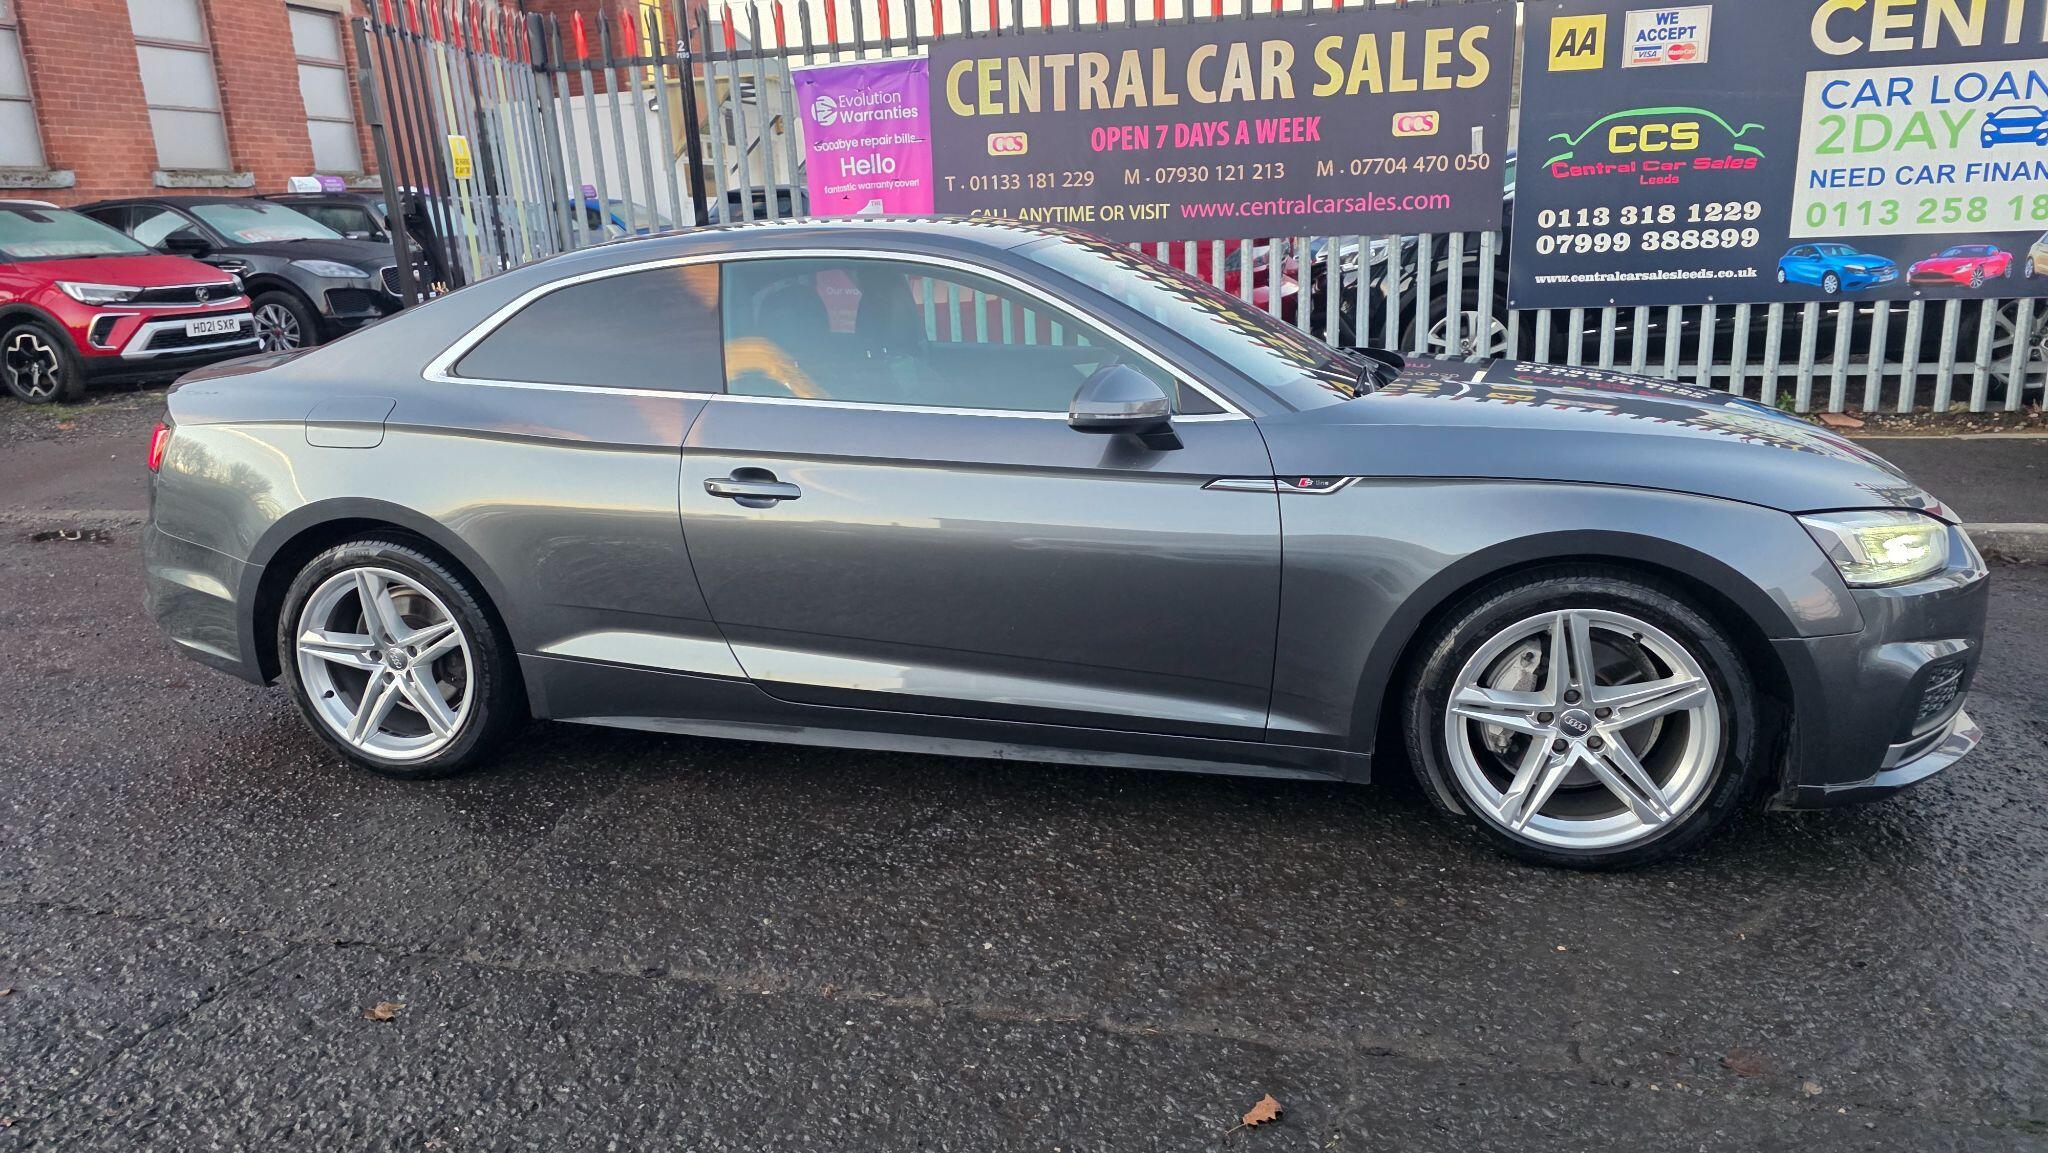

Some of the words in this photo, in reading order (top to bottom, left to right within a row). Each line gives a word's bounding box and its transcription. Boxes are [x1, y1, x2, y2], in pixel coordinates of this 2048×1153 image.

[1656, 12, 1679, 25] WE
[1555, 27, 1597, 57] AA
[1636, 26, 1697, 42] ACCEPT
[677, 40, 685, 51] 2
[1638, 50, 1657, 58] VISA
[946, 48, 1179, 117] CENTRAL
[1187, 39, 1295, 104] CAR
[1312, 25, 1490, 97] SALES
[838, 91, 902, 108] Evolution
[1821, 77, 1914, 110] CAR
[840, 105, 918, 124] Warranties
[814, 139, 858, 152] Goodbye
[860, 134, 893, 148] repair
[1091, 125, 1149, 152] OPEN
[1156, 125, 1169, 149] 7
[1174, 121, 1230, 148] DAYS
[1235, 120, 1250, 145] A
[1255, 116, 1321, 144] WEEK
[1608, 121, 1700, 154] CCS
[1815, 109, 1977, 155] 2DAY
[840, 153, 896, 178] Hello
[1155, 166, 1208, 184] 07930
[1215, 164, 1244, 181] 121
[1252, 162, 1285, 180] 213
[1350, 157, 1407, 176] 07704
[1413, 155, 1448, 173] 470
[1455, 153, 1490, 170] 050
[1551, 161, 1636, 179] Central
[1642, 160, 1687, 172] Car
[1692, 155, 1758, 170] Sales
[824, 183, 857, 194] fantastic
[858, 181, 894, 190] warranty
[894, 179, 920, 187] cover!
[969, 173, 1021, 191] 01133
[1027, 173, 1055, 189] 181
[1063, 170, 1095, 187] 229
[1640, 174, 1679, 185] Leeds
[1809, 167, 1886, 188] NEED
[1895, 164, 1956, 186] CAR
[1018, 205, 1095, 223] ANYTIME
[1100, 204, 1124, 222] OR
[1129, 203, 1171, 220] VISIT
[1180, 191, 1450, 218] www.centralcarsales.com
[1537, 207, 1610, 229] 0113
[1620, 204, 1676, 225] 318
[1687, 200, 1762, 223] 1229
[1805, 200, 1900, 228] 0113
[1915, 196, 1988, 224] 258
[1535, 232, 1631, 255] 07999
[1641, 228, 1760, 251] 388899
[1535, 267, 1758, 284] www.centralcarsalesleeds.co.uk
[826, 286, 843, 296] Our
[193, 320, 215, 334] HD21
[217, 318, 235, 331] SXR
